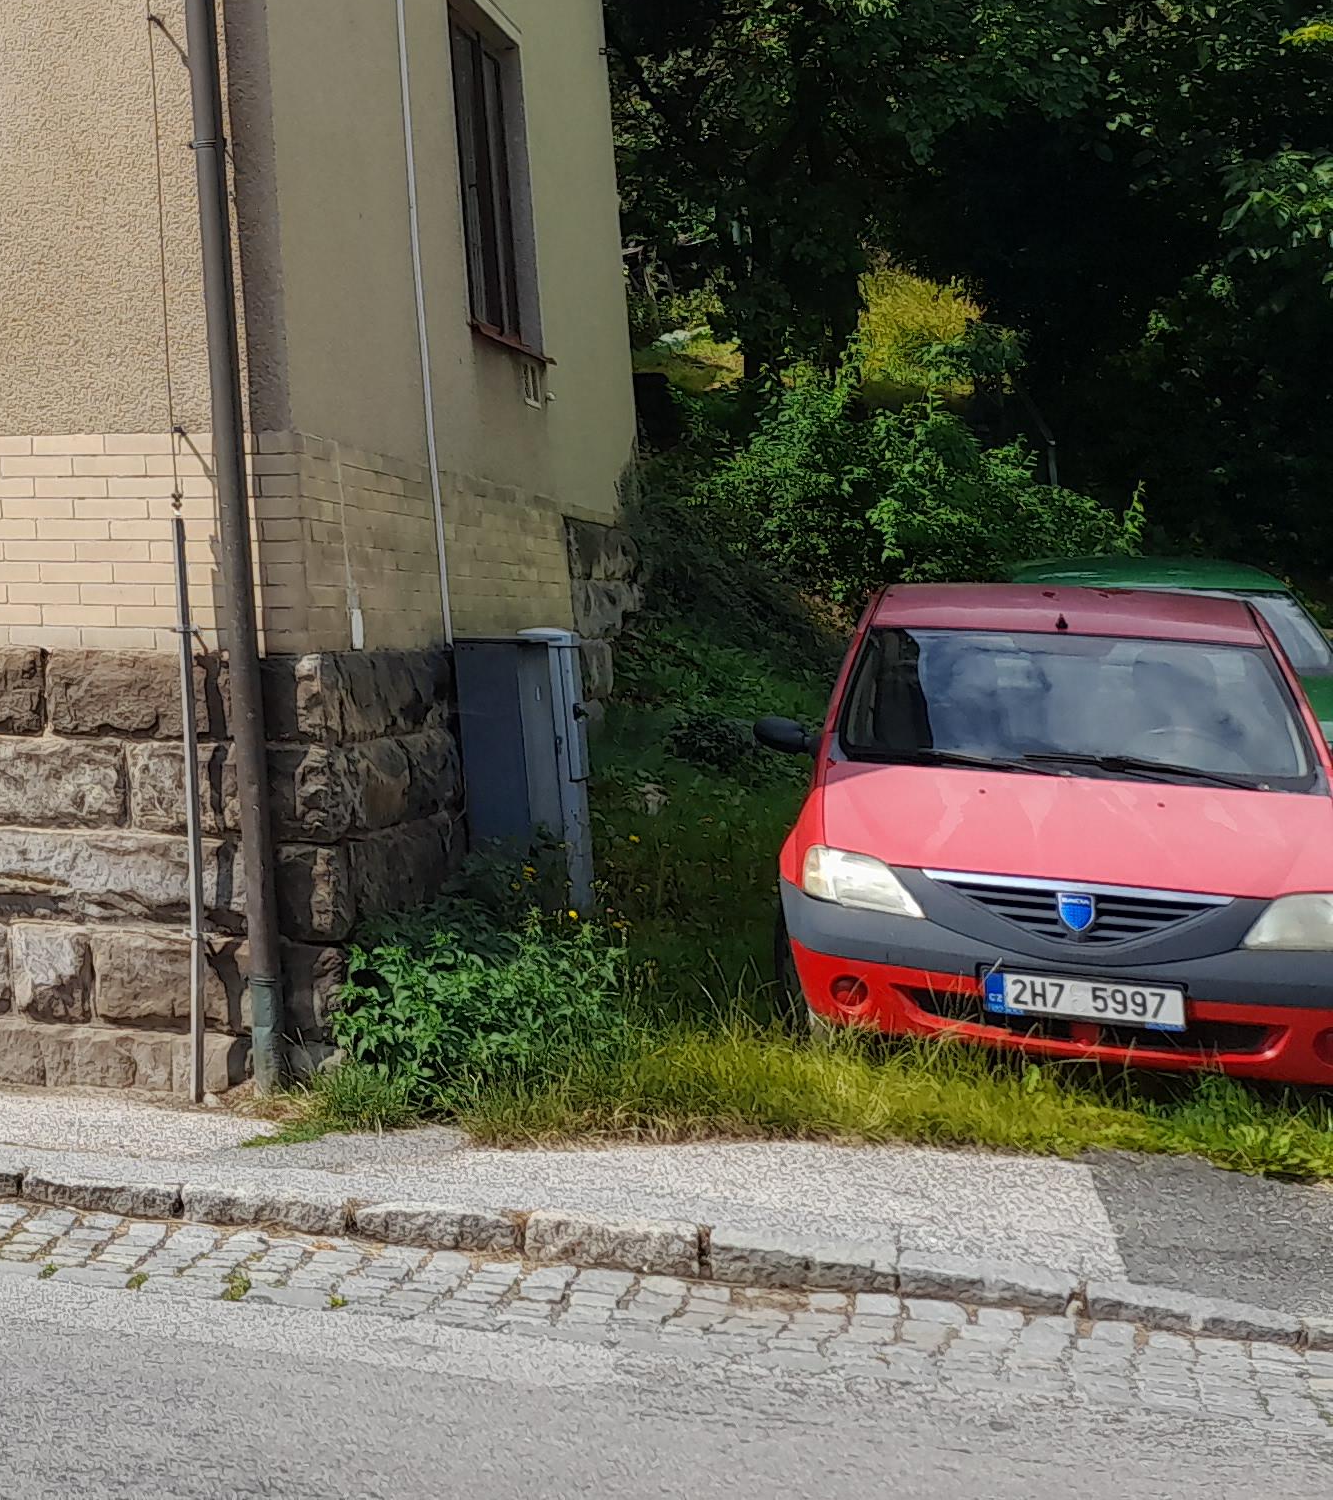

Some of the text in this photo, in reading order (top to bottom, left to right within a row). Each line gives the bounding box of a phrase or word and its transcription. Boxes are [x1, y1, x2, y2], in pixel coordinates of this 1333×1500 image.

[988, 992, 1003, 1003] CZ
[1011, 978, 1167, 1019] 2H7 5997
